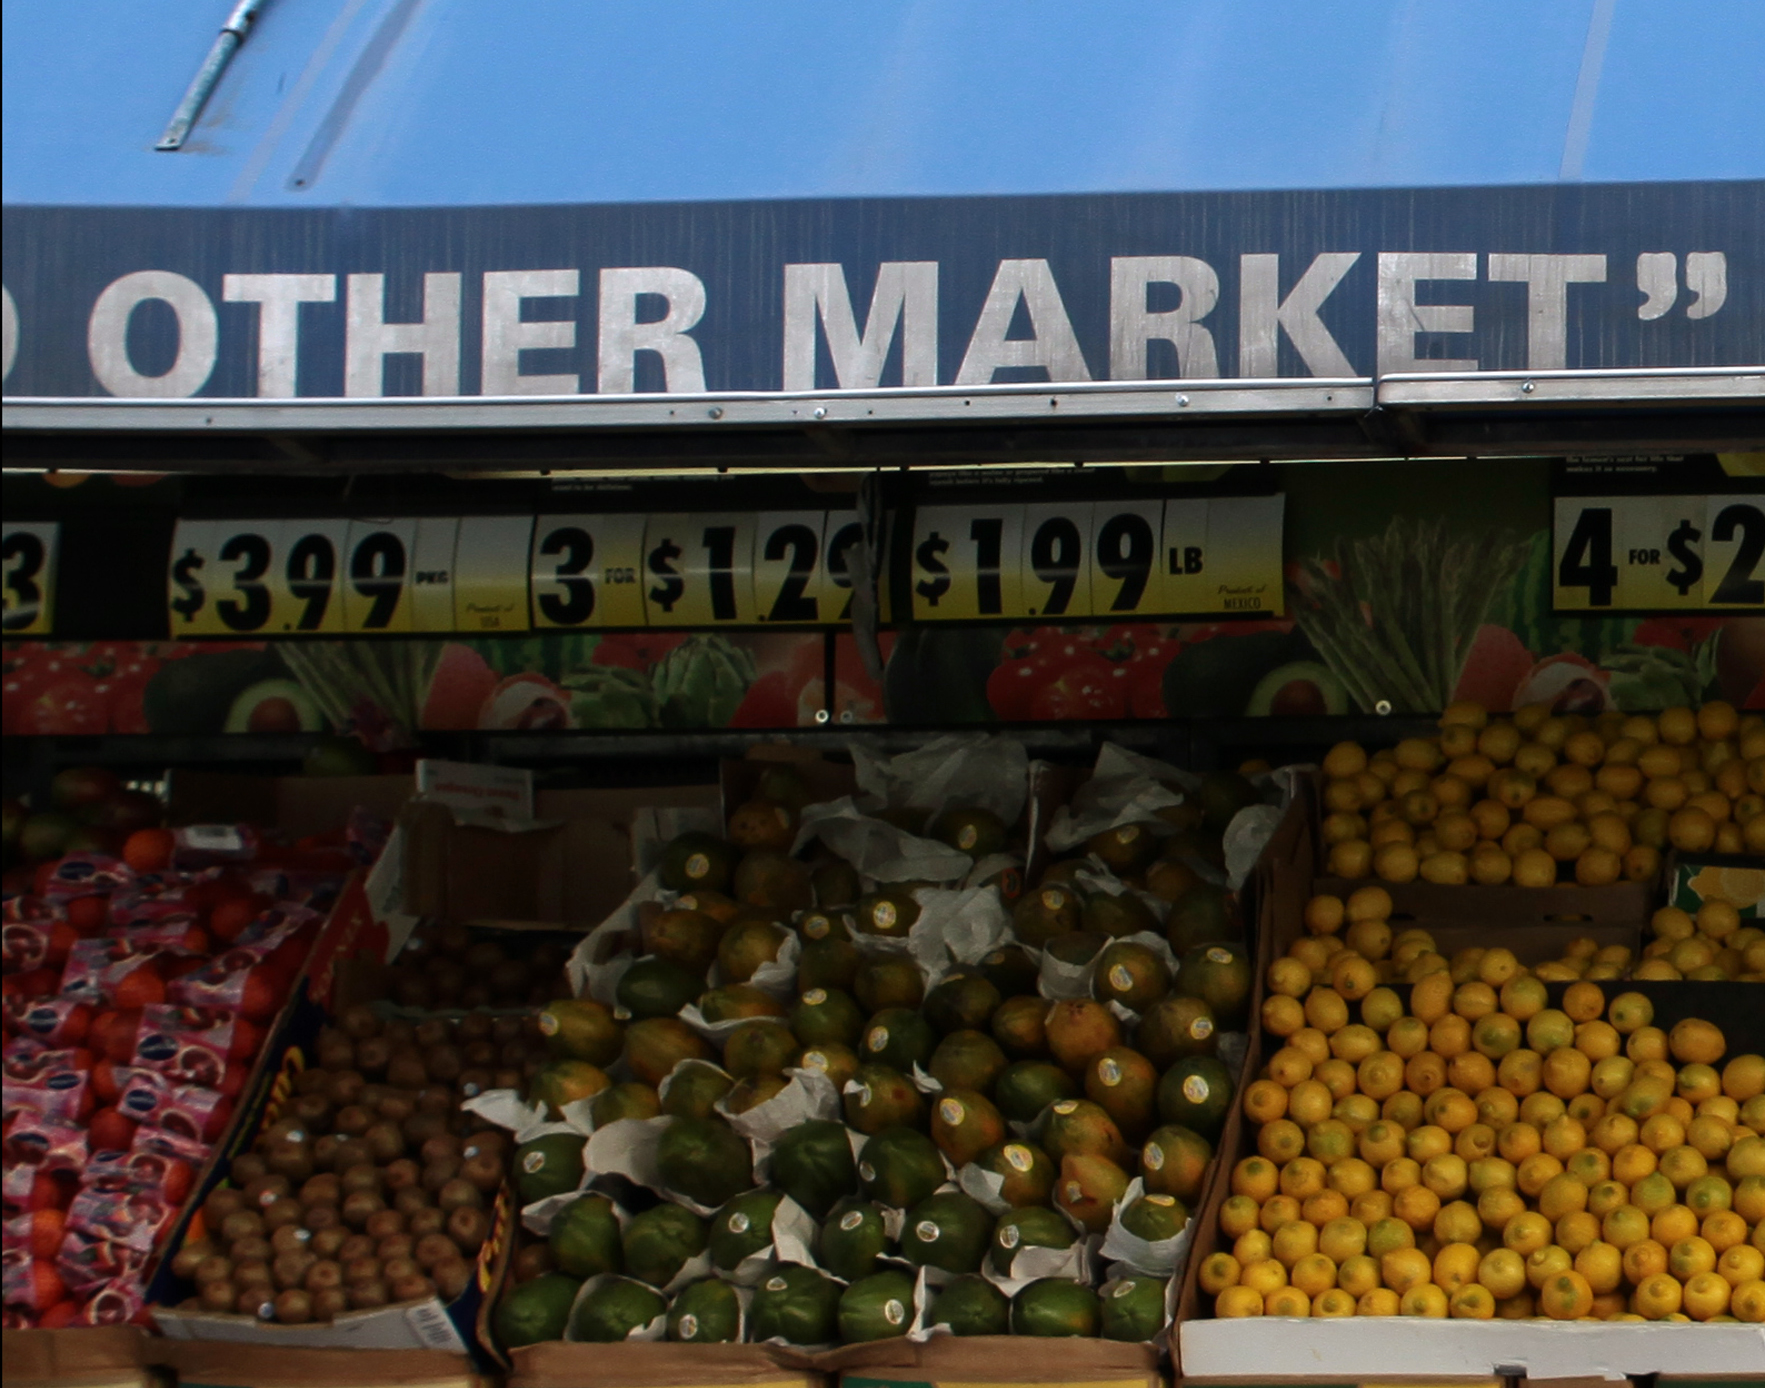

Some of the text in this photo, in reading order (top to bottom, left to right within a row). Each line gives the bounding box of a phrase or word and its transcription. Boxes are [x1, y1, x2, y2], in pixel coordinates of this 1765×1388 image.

[87, 266, 706, 399] OTHER
[172, 531, 405, 631] $3.99
[915, 513, 1203, 617] $1.99 LB
[1559, 508, 1617, 606] 4
[1629, 549, 1661, 565] FOR
